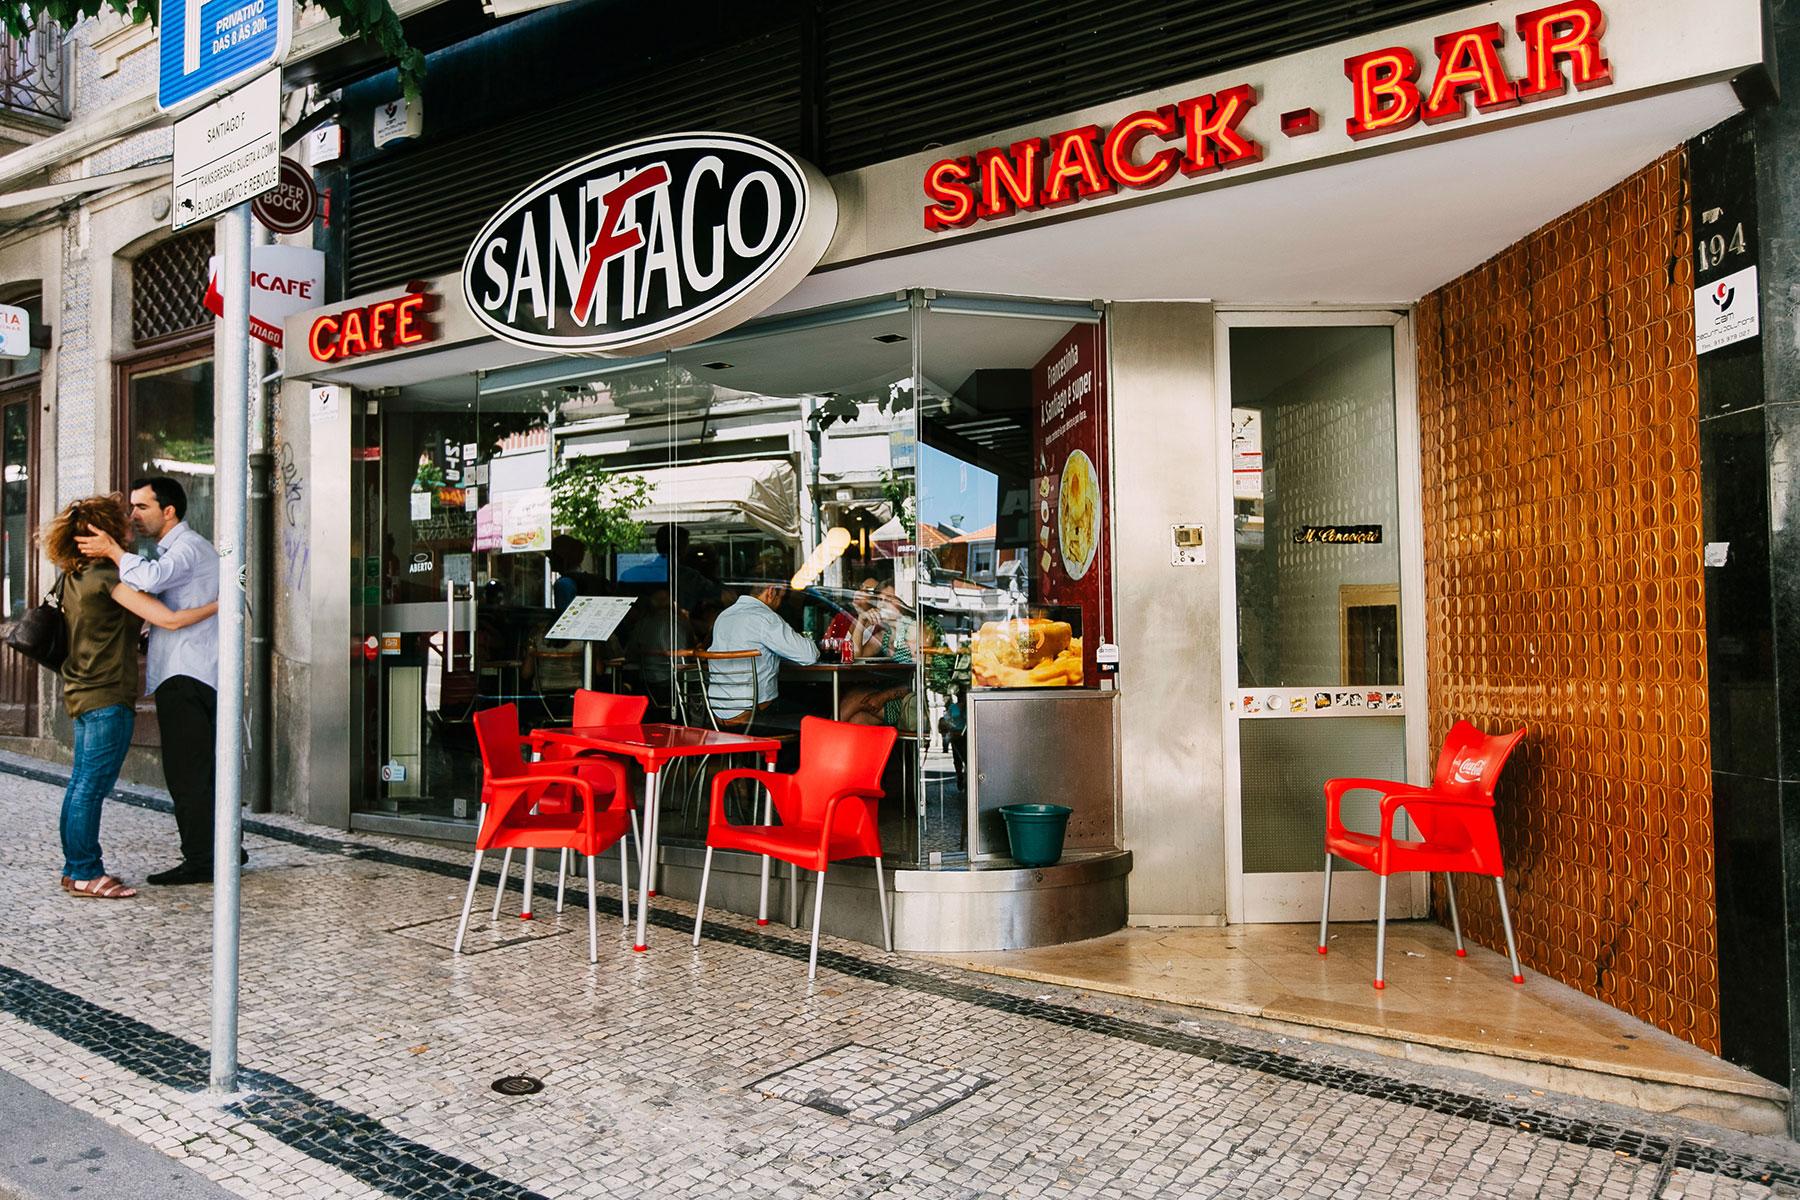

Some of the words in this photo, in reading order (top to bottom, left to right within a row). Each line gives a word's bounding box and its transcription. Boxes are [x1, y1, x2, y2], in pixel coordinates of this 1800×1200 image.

[212, 34, 231, 55] DAS
[231, 31, 237, 46] 8
[251, 17, 268, 36] 20h
[216, 1, 264, 34] PRIVATIVO
[206, 115, 241, 144] SANTIAGO
[922, 84, 1264, 233] SNACK
[1342, 0, 1615, 142] BAR
[243, 179, 249, 196] E
[248, 165, 277, 192] REBOQUE
[272, 182, 304, 201] PER
[263, 191, 302, 213] BOCK
[483, 155, 782, 331] SANTIAGO
[1698, 221, 1746, 273] 194
[308, 279, 433, 363] CAFÉ
[1048, 344, 1078, 389] Francesinha
[1045, 389, 1068, 424] Santiago
[1072, 370, 1092, 405] super
[409, 561, 433, 574] ABERTO
